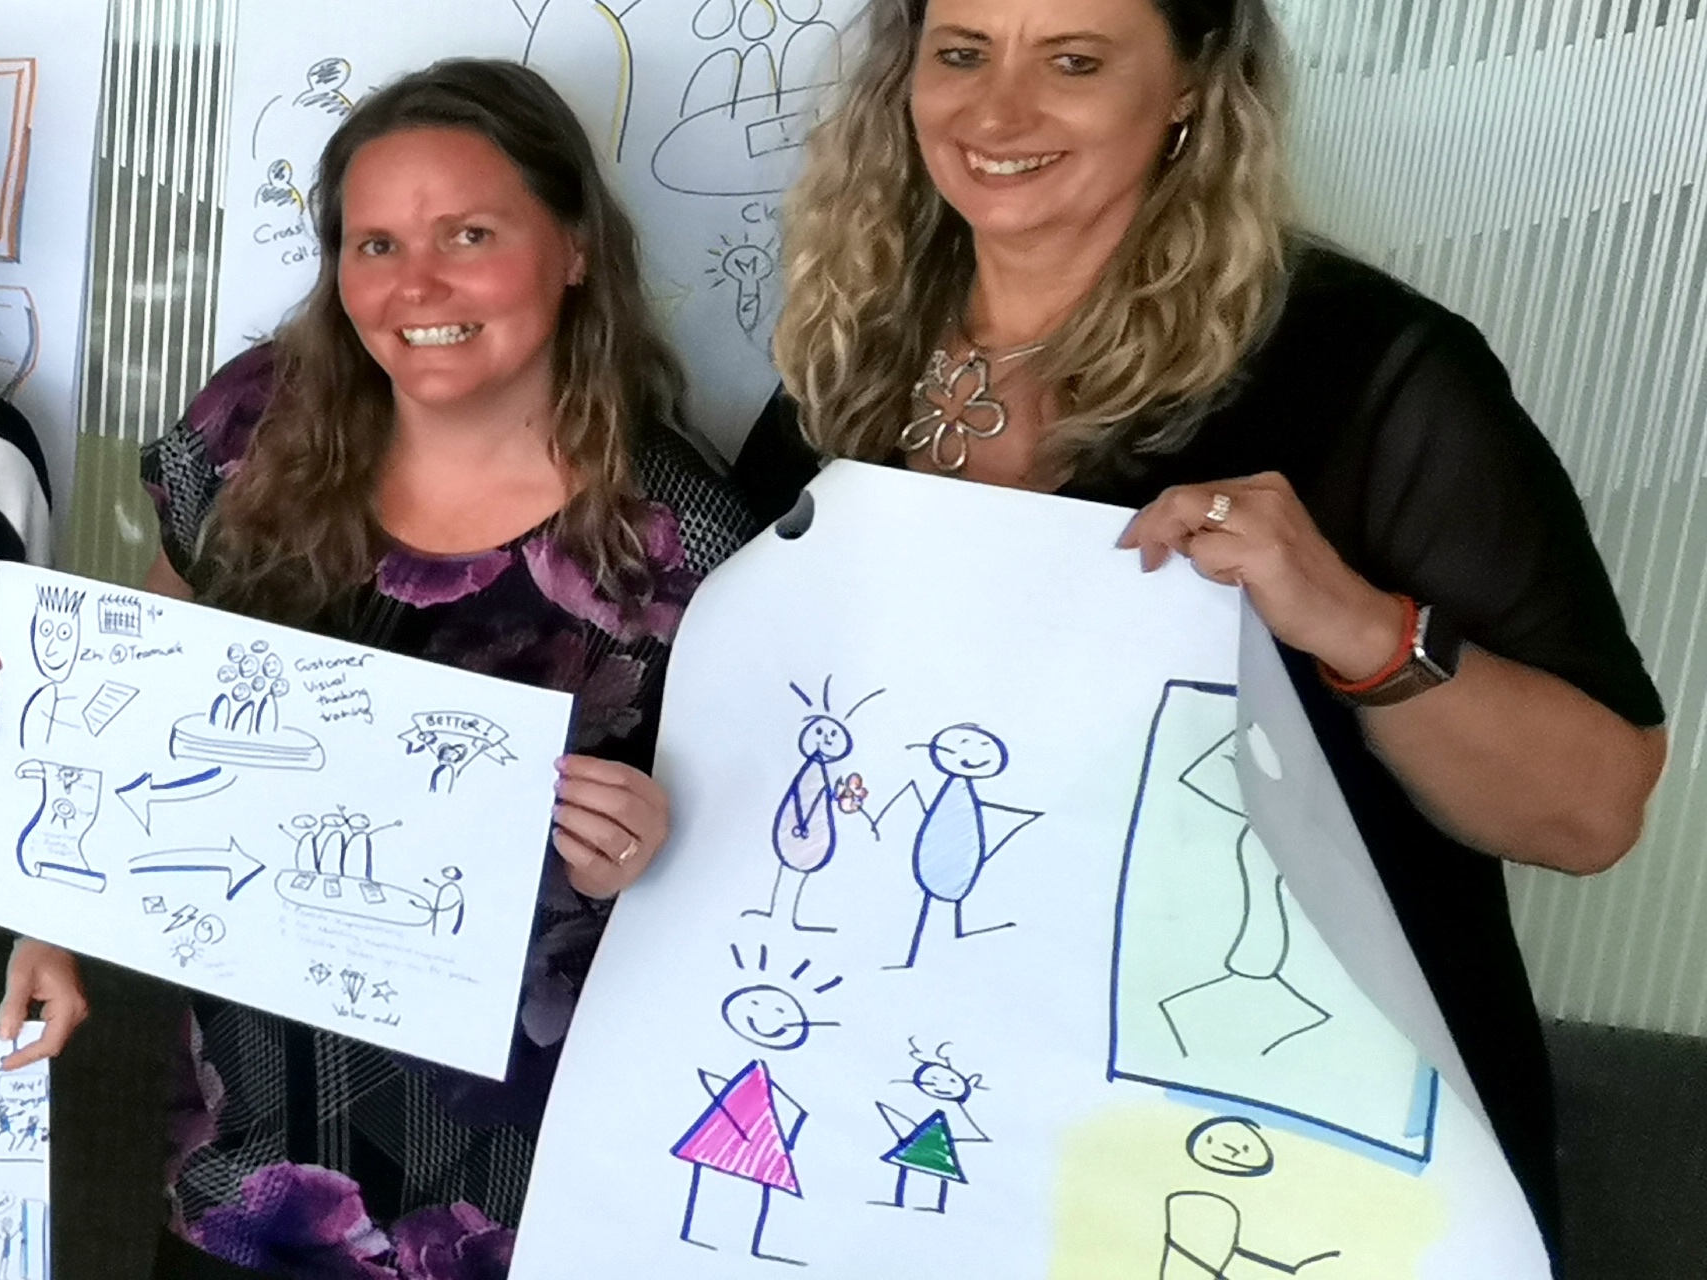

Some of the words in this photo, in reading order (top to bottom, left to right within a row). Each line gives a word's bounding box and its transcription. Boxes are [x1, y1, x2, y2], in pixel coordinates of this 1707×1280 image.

[294, 652, 376, 672] Customer
[302, 672, 347, 694] Visual
[373, 1012, 402, 1027] add
